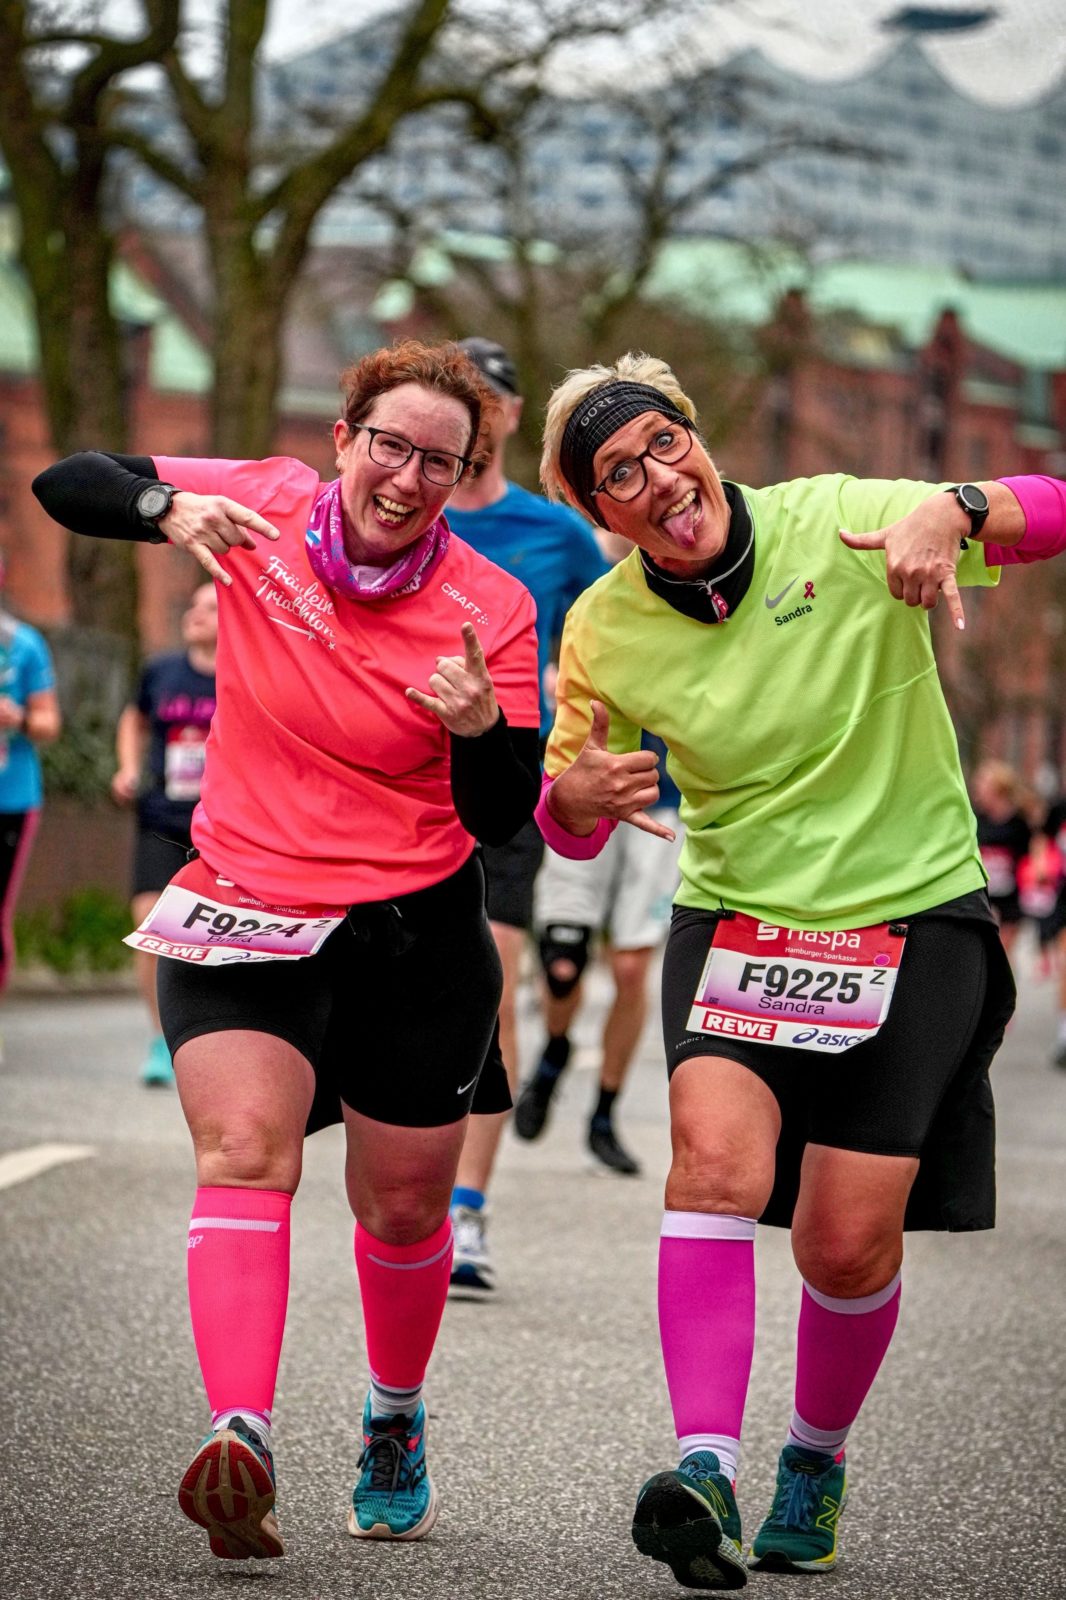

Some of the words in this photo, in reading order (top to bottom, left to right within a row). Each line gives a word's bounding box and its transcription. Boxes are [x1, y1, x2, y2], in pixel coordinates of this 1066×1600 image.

[580, 396, 616, 427] GORE
[264, 555, 335, 616] Fräulein
[441, 582, 482, 616] CRAFT
[774, 604, 813, 626] Sandra
[182, 902, 307, 938] F9224
[312, 919, 332, 929] Z
[142, 937, 206, 961] REWE
[785, 946, 822, 958] Hamburger
[823, 951, 858, 963] Sparkasse
[738, 961, 863, 1004] F9225
[869, 969, 888, 985] Z
[758, 996, 825, 1015] Sandra
[705, 1013, 775, 1038] REWE
